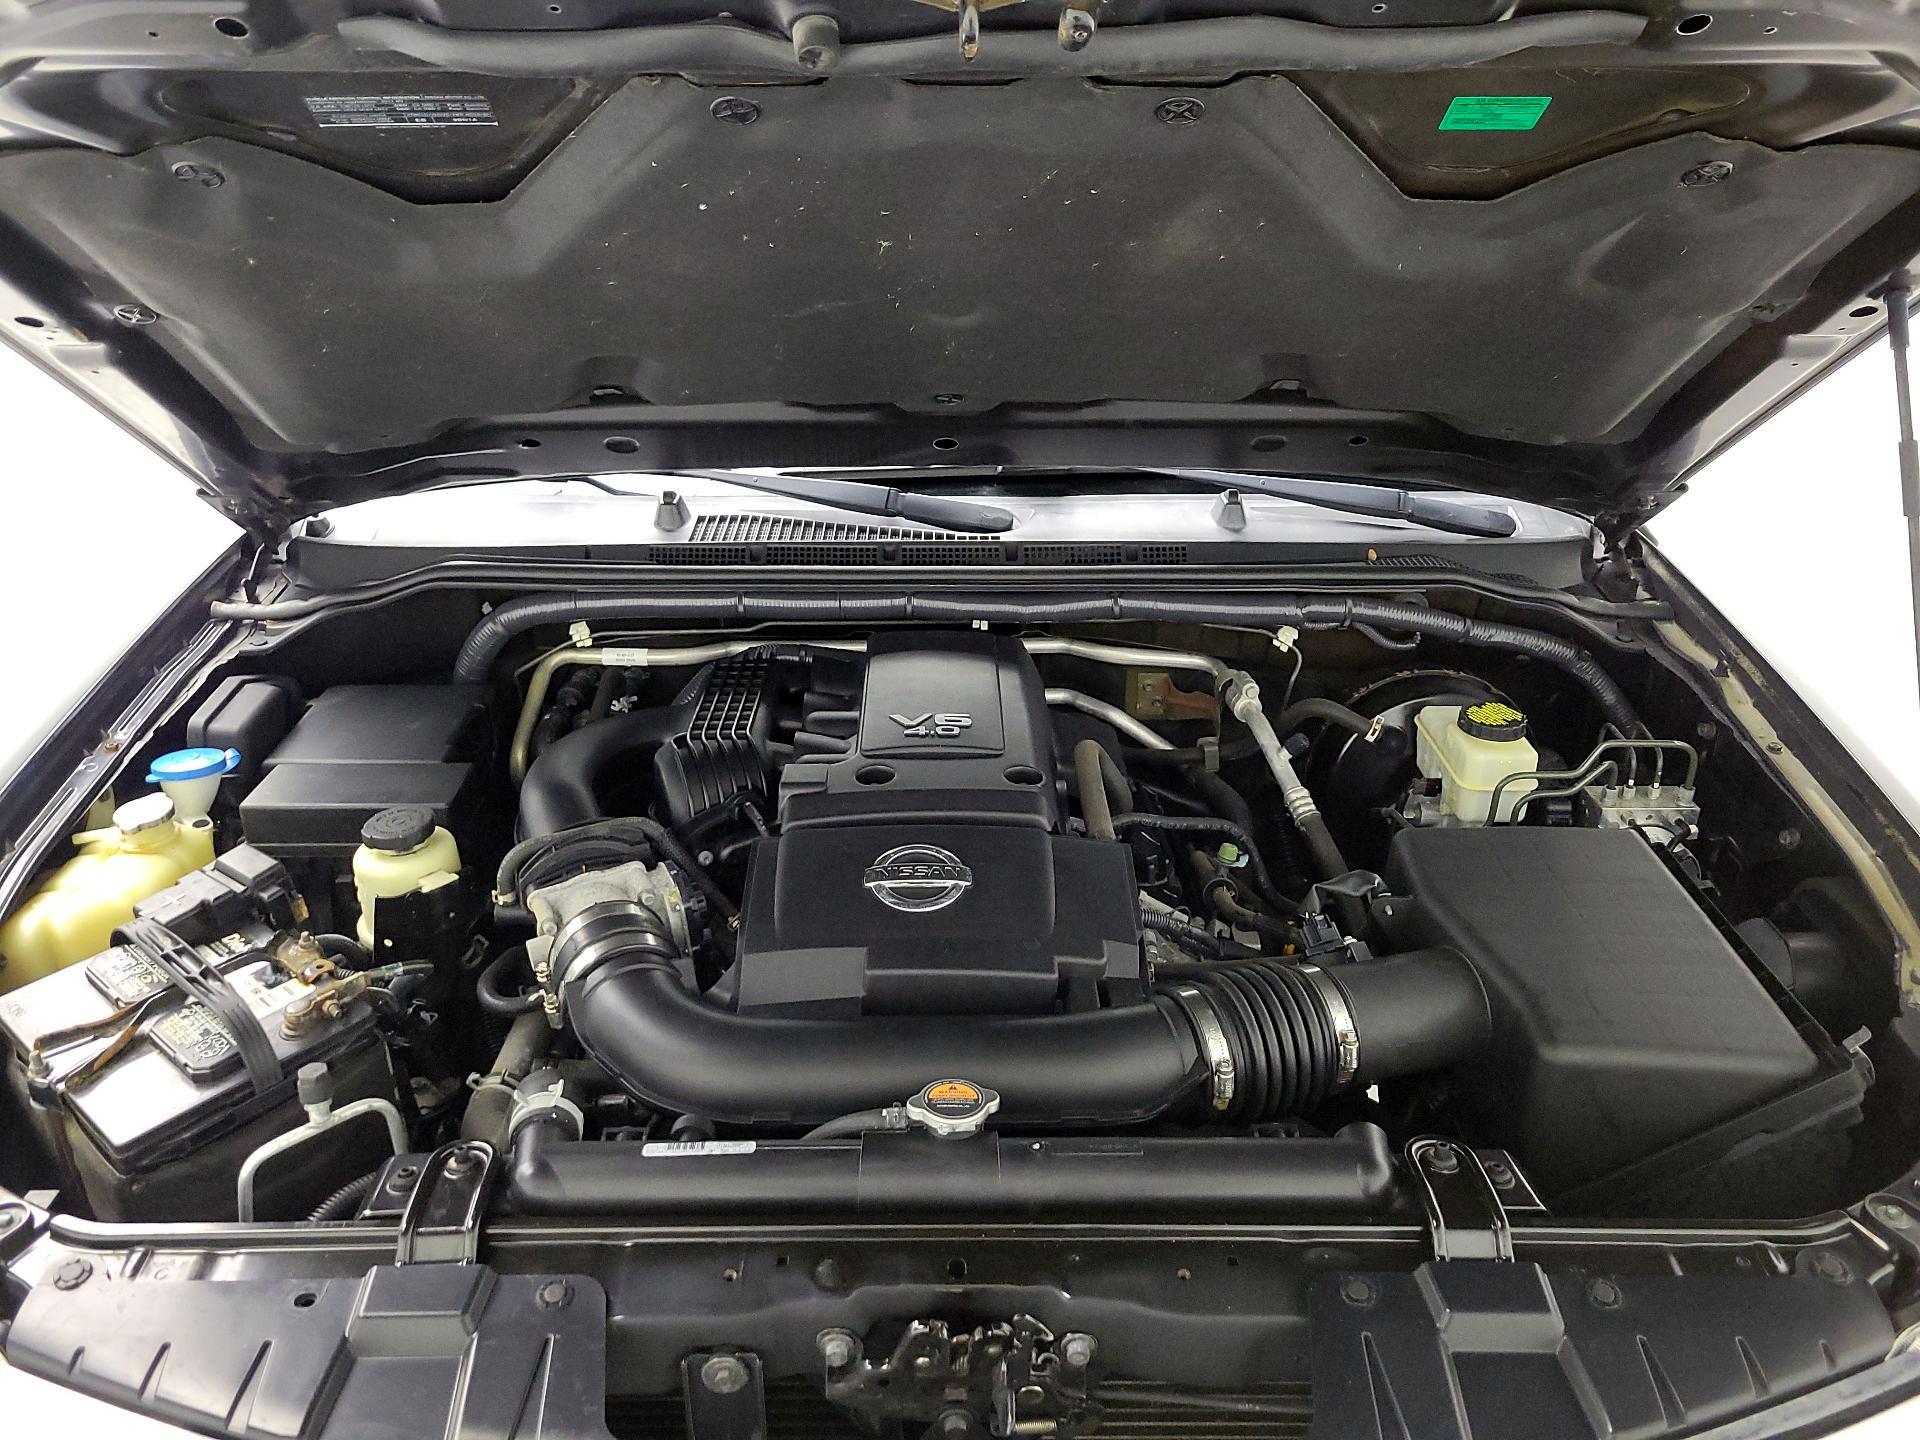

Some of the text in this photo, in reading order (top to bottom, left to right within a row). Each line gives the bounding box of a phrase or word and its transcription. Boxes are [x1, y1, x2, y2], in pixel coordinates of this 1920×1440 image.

[889, 713, 972, 728] V6
[903, 725, 960, 736] 4.0
[875, 865, 961, 878] NISSAN
